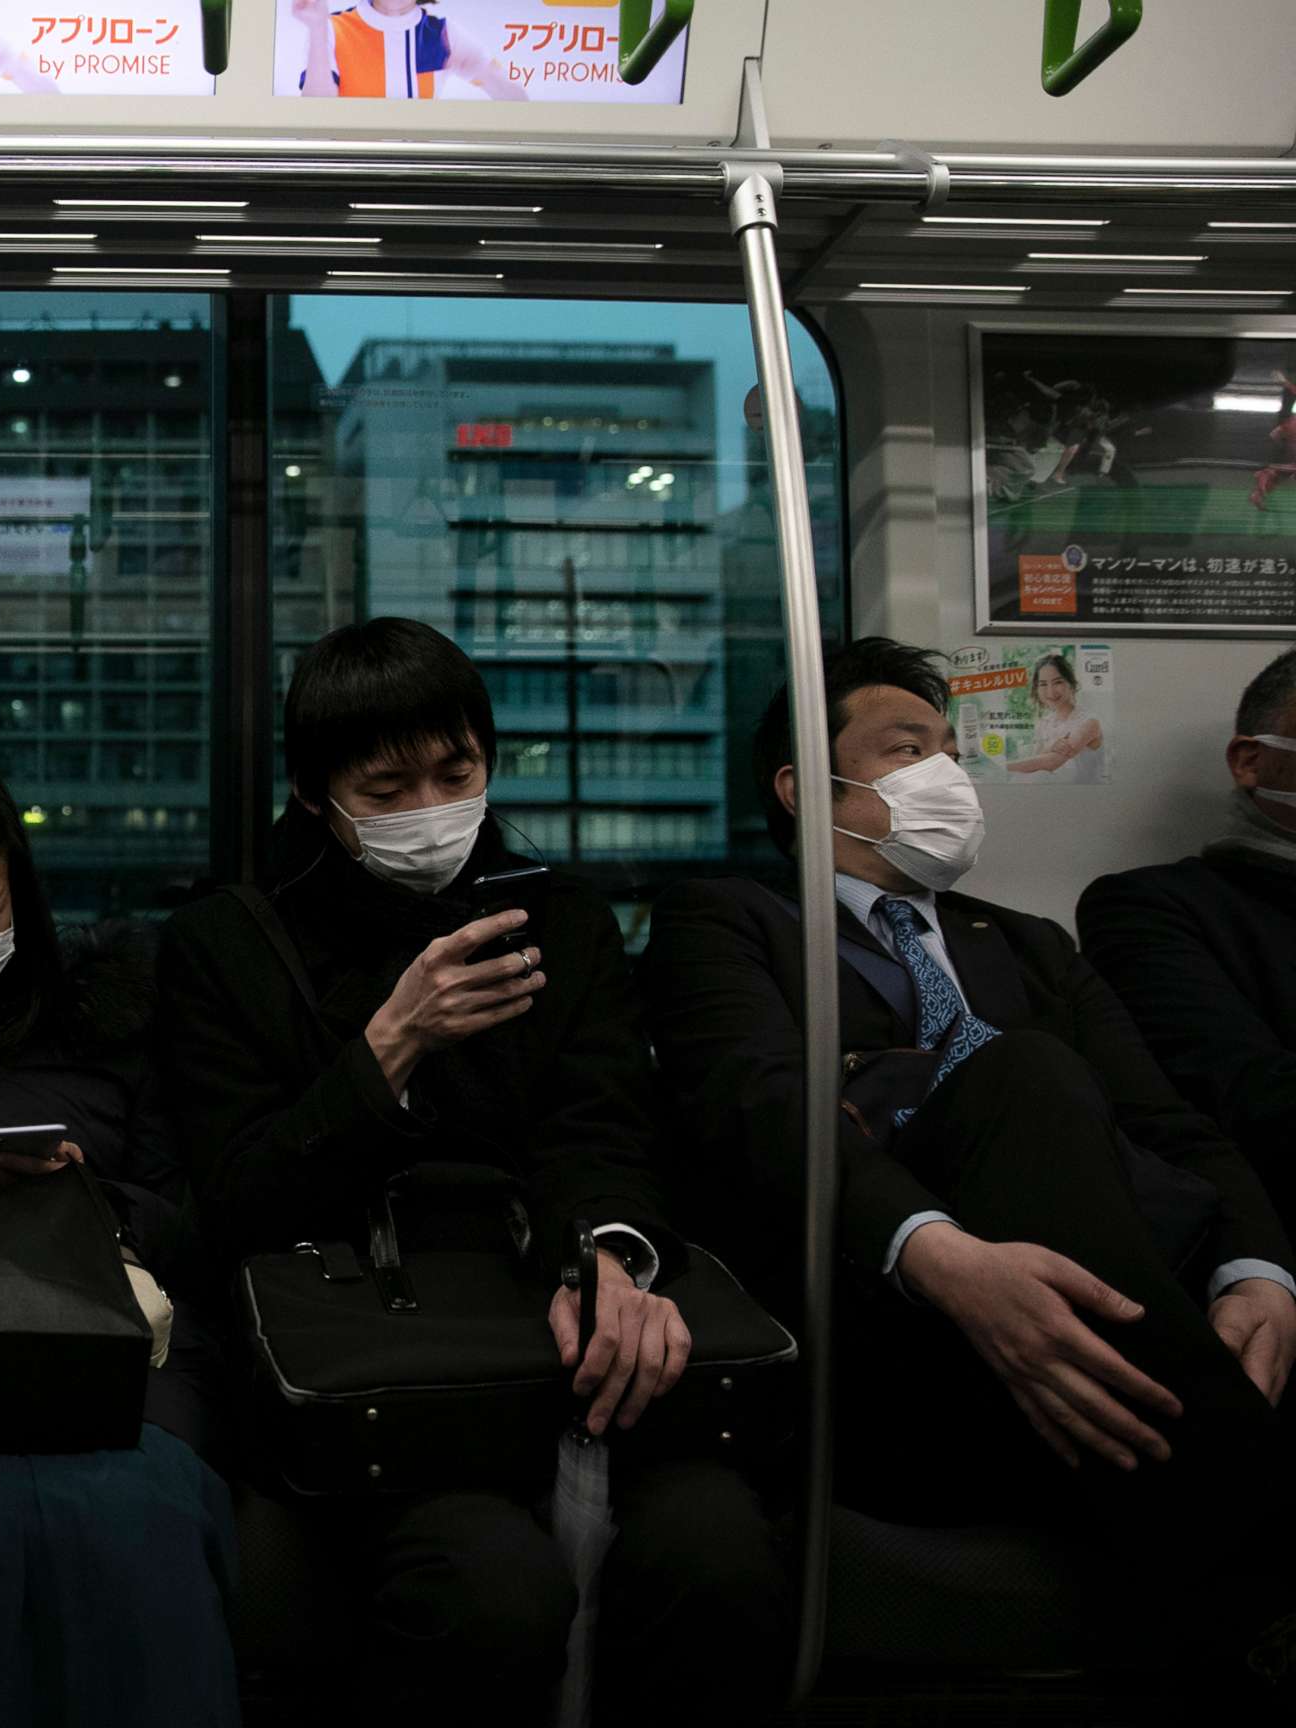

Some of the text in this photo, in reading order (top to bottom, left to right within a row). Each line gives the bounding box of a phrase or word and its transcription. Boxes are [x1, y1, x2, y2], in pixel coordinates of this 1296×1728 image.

[31, 15, 179, 46] アプリローン
[503, 21, 621, 53] アプリロー
[39, 54, 171, 80] by PROMISE
[509, 61, 535, 87] by
[1091, 557, 1296, 576] マンツーマンは、初速が違う。
